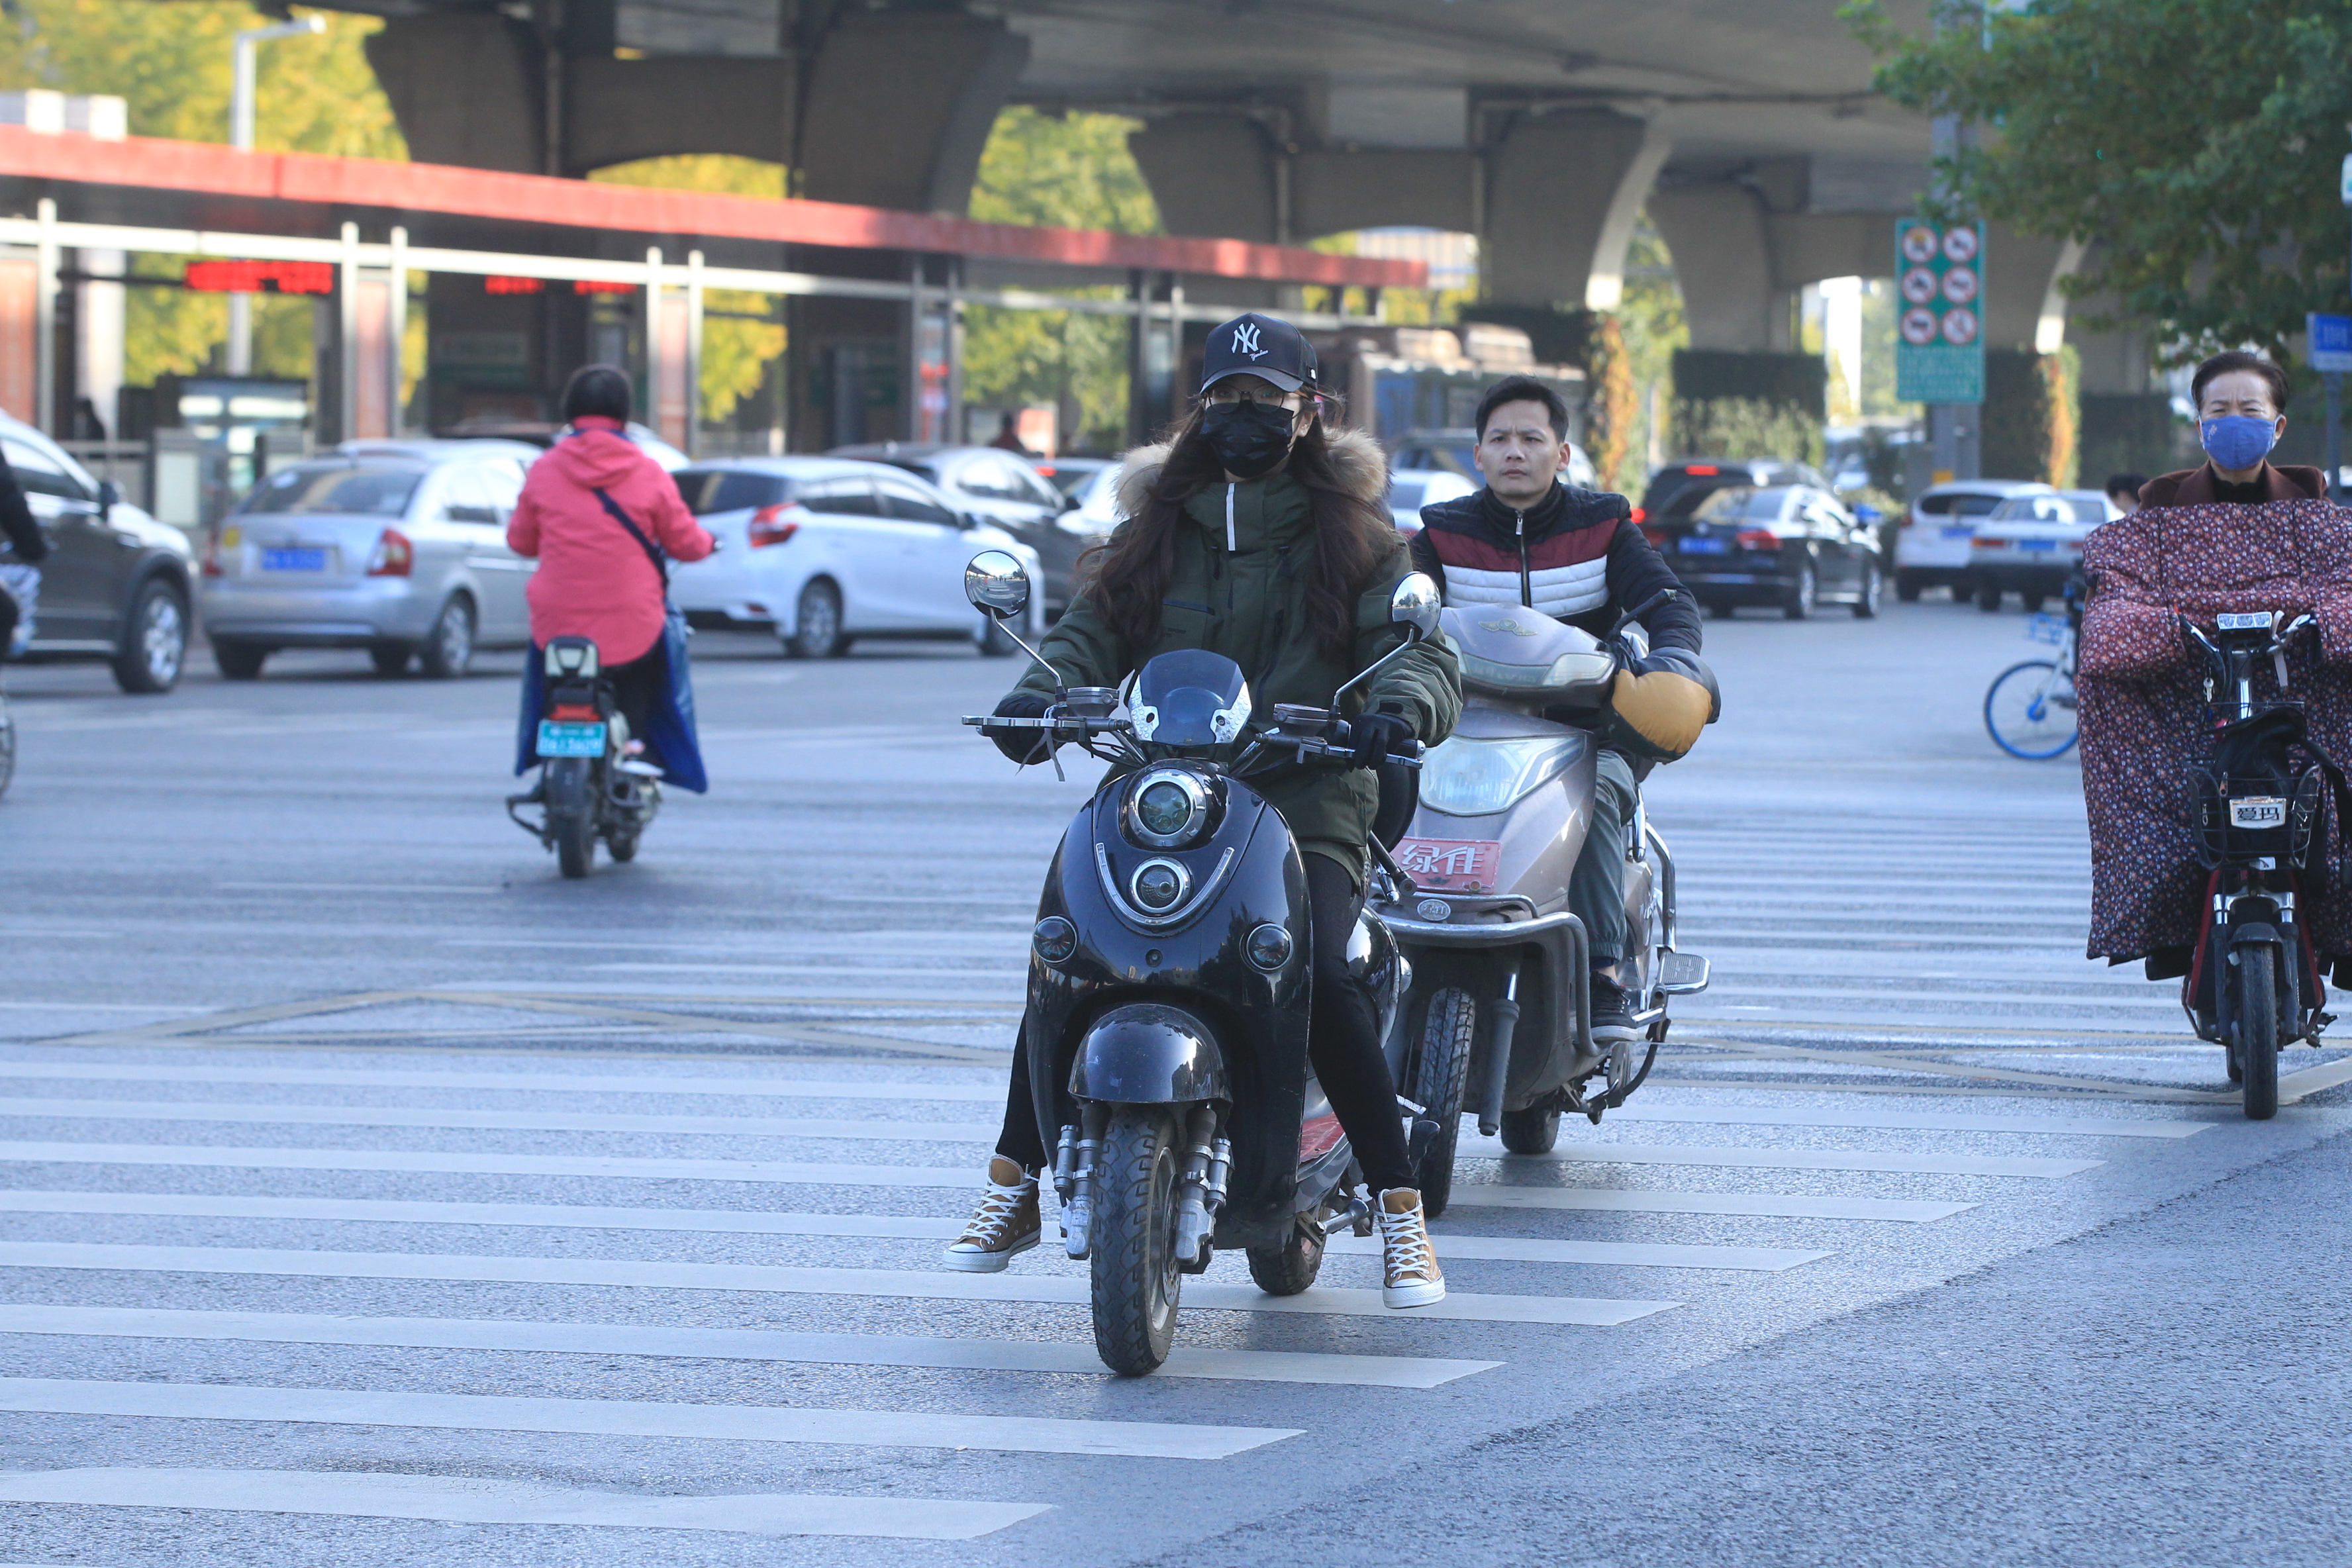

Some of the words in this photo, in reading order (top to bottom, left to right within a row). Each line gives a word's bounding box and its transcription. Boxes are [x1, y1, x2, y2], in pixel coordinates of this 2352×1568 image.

[1232, 322, 1261, 354] NY
[2237, 807, 2279, 821] 爱玛
[1400, 844, 1484, 876] 绿佳
